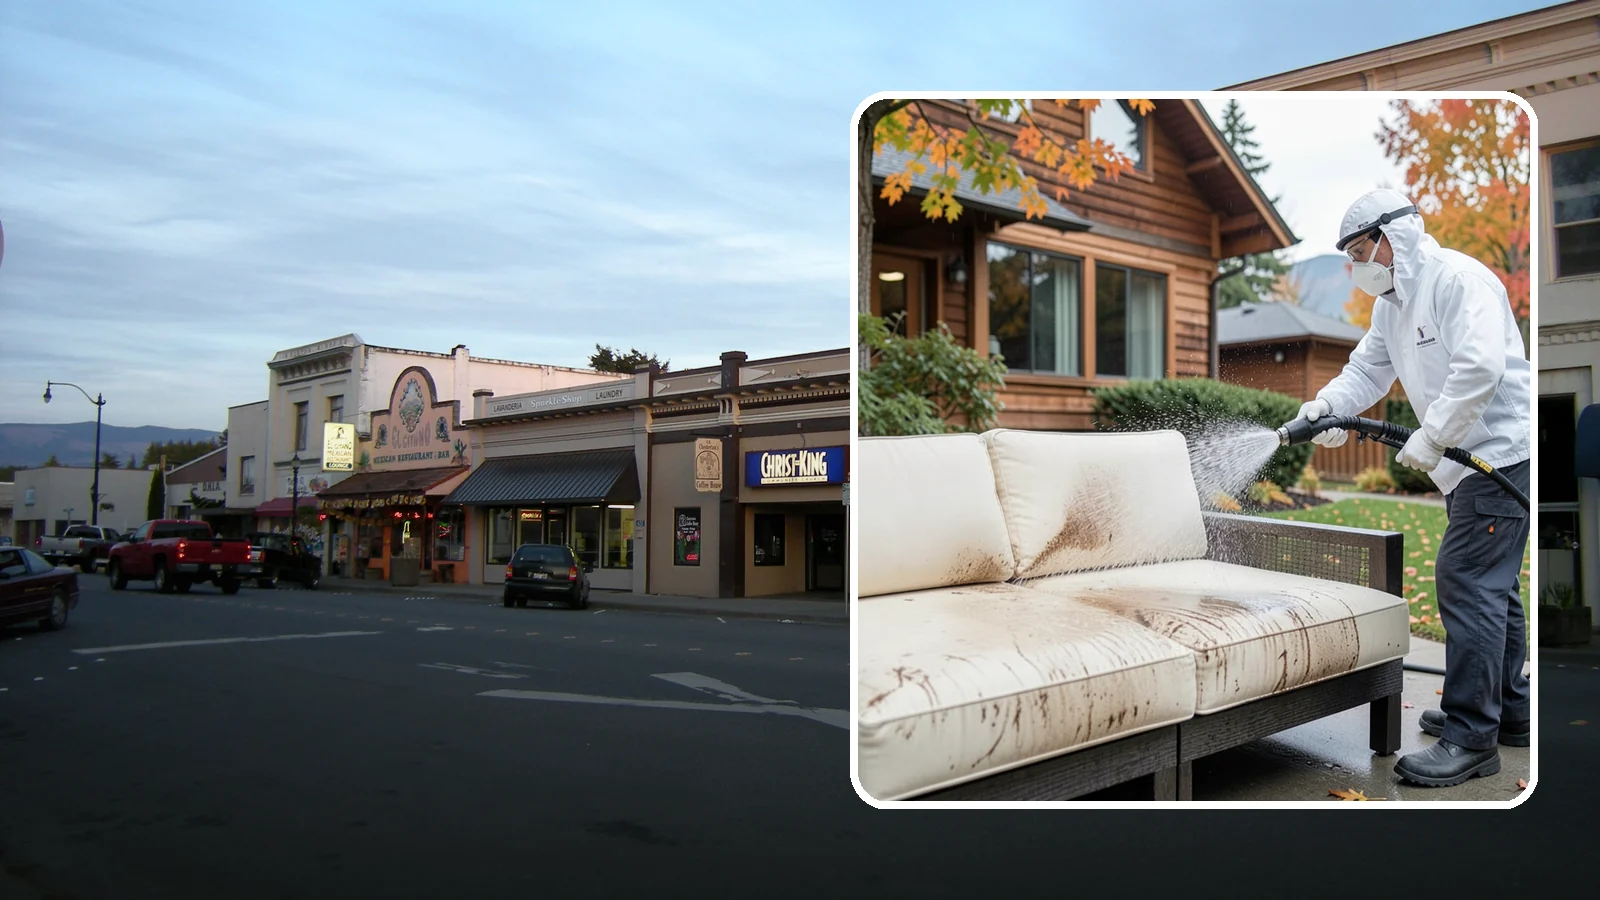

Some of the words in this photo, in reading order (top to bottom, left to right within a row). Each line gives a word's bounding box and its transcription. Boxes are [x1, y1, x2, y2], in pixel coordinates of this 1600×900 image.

[595, 389, 623, 400] LAUNDRY
[531, 396, 561, 408] Sparkle
[562, 394, 582, 404] Shop
[493, 402, 522, 412] LAVANDERIA
[398, 452, 433, 462] RESTAURANT
[438, 450, 450, 459] BAR
[761, 452, 797, 478] CHRIST
[799, 450, 827, 476] KING
[697, 481, 709, 489] Coffee
[710, 481, 721, 489] House
